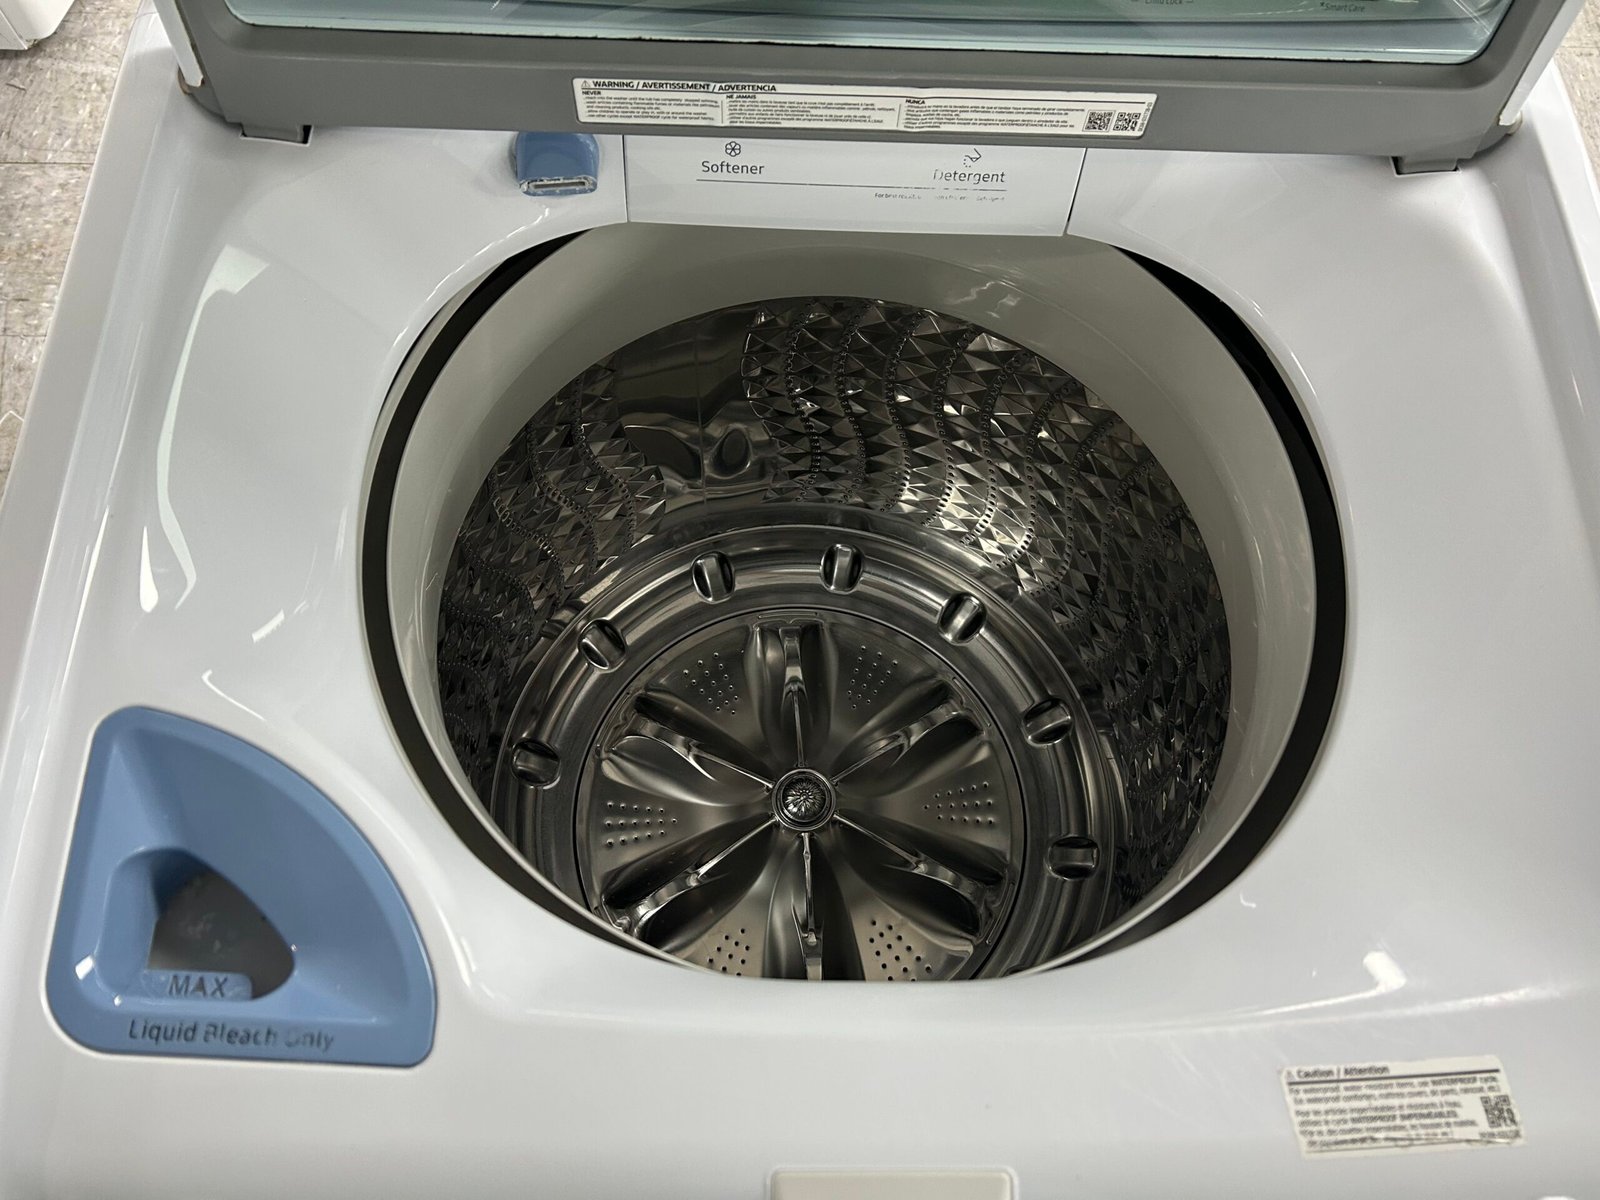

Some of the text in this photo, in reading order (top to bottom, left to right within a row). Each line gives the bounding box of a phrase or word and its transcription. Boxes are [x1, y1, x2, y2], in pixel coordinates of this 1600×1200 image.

[592, 80, 635, 89] WARNING
[642, 82, 710, 91] AVERTISSEMENT
[718, 84, 777, 92] ADVERTENCIA
[701, 160, 1006, 185] Softener Detergent
[168, 975, 229, 998] MAX
[128, 1019, 199, 1044] Liquid
[1343, 1065, 1390, 1076] Attention
